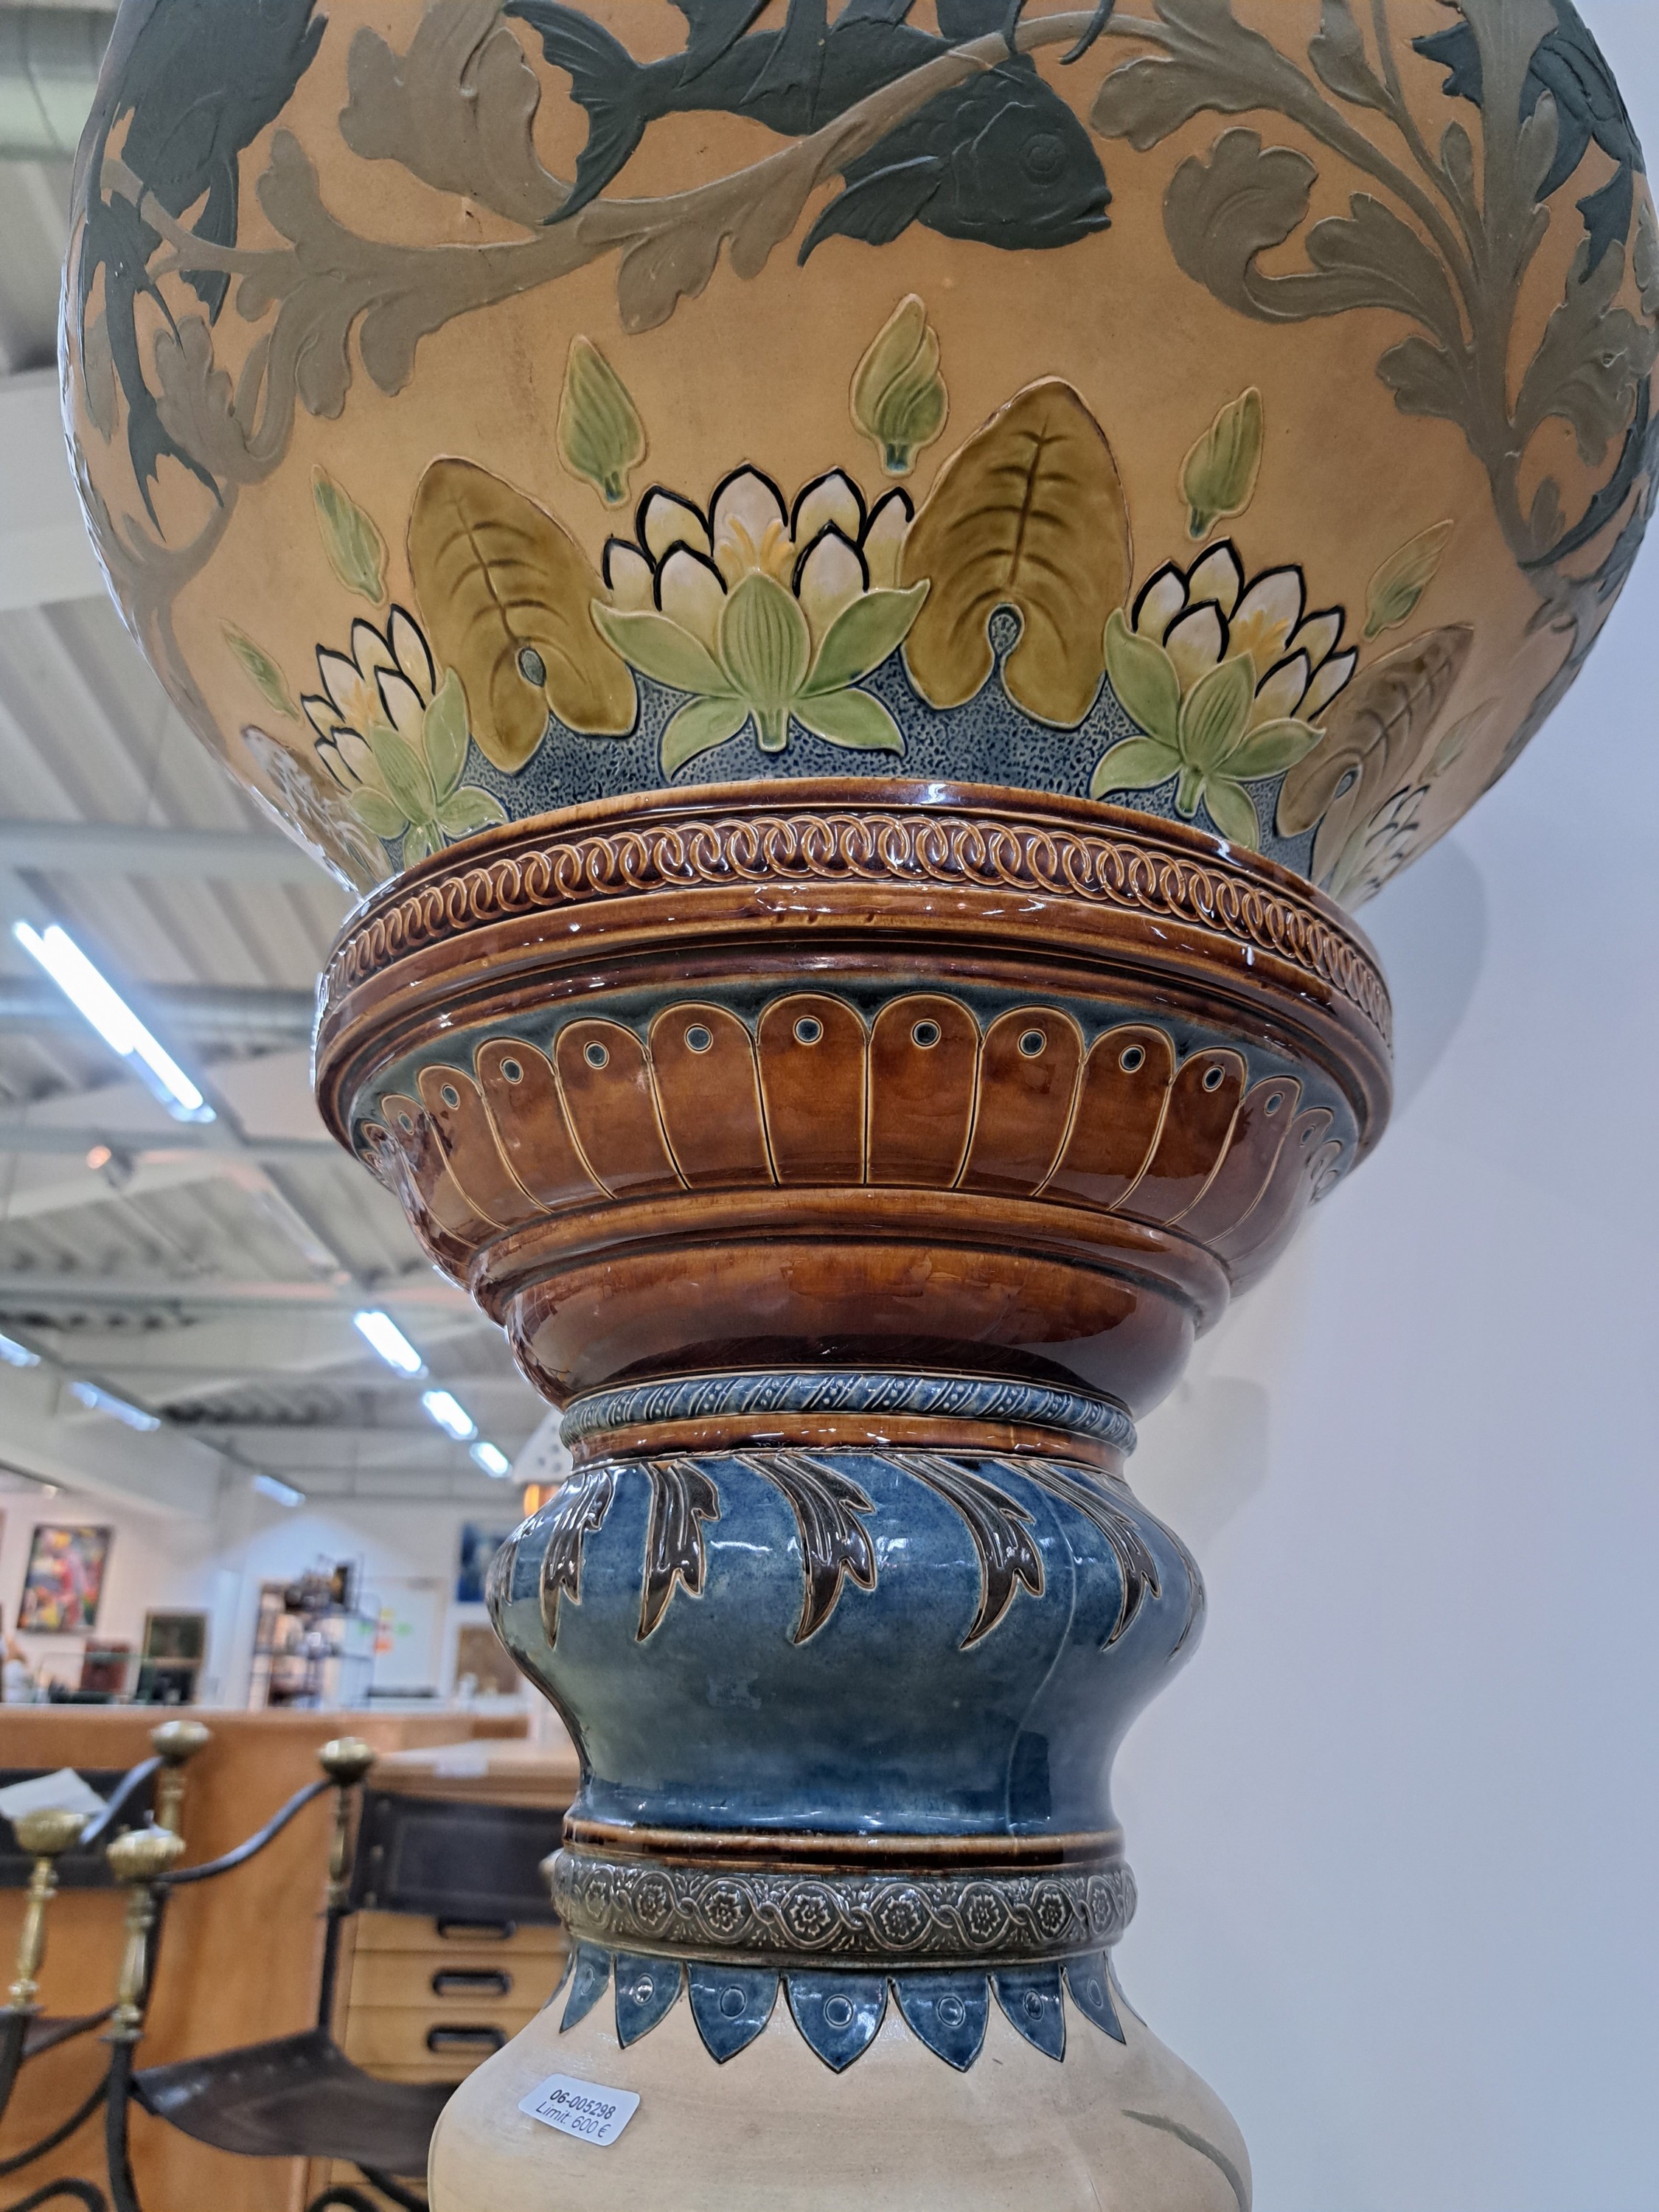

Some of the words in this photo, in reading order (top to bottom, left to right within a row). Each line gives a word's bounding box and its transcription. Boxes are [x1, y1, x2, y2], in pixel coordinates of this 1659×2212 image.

[550, 2089, 616, 2120] 06-005298
[571, 2116, 599, 2134] 600
[597, 2124, 611, 2138] €
